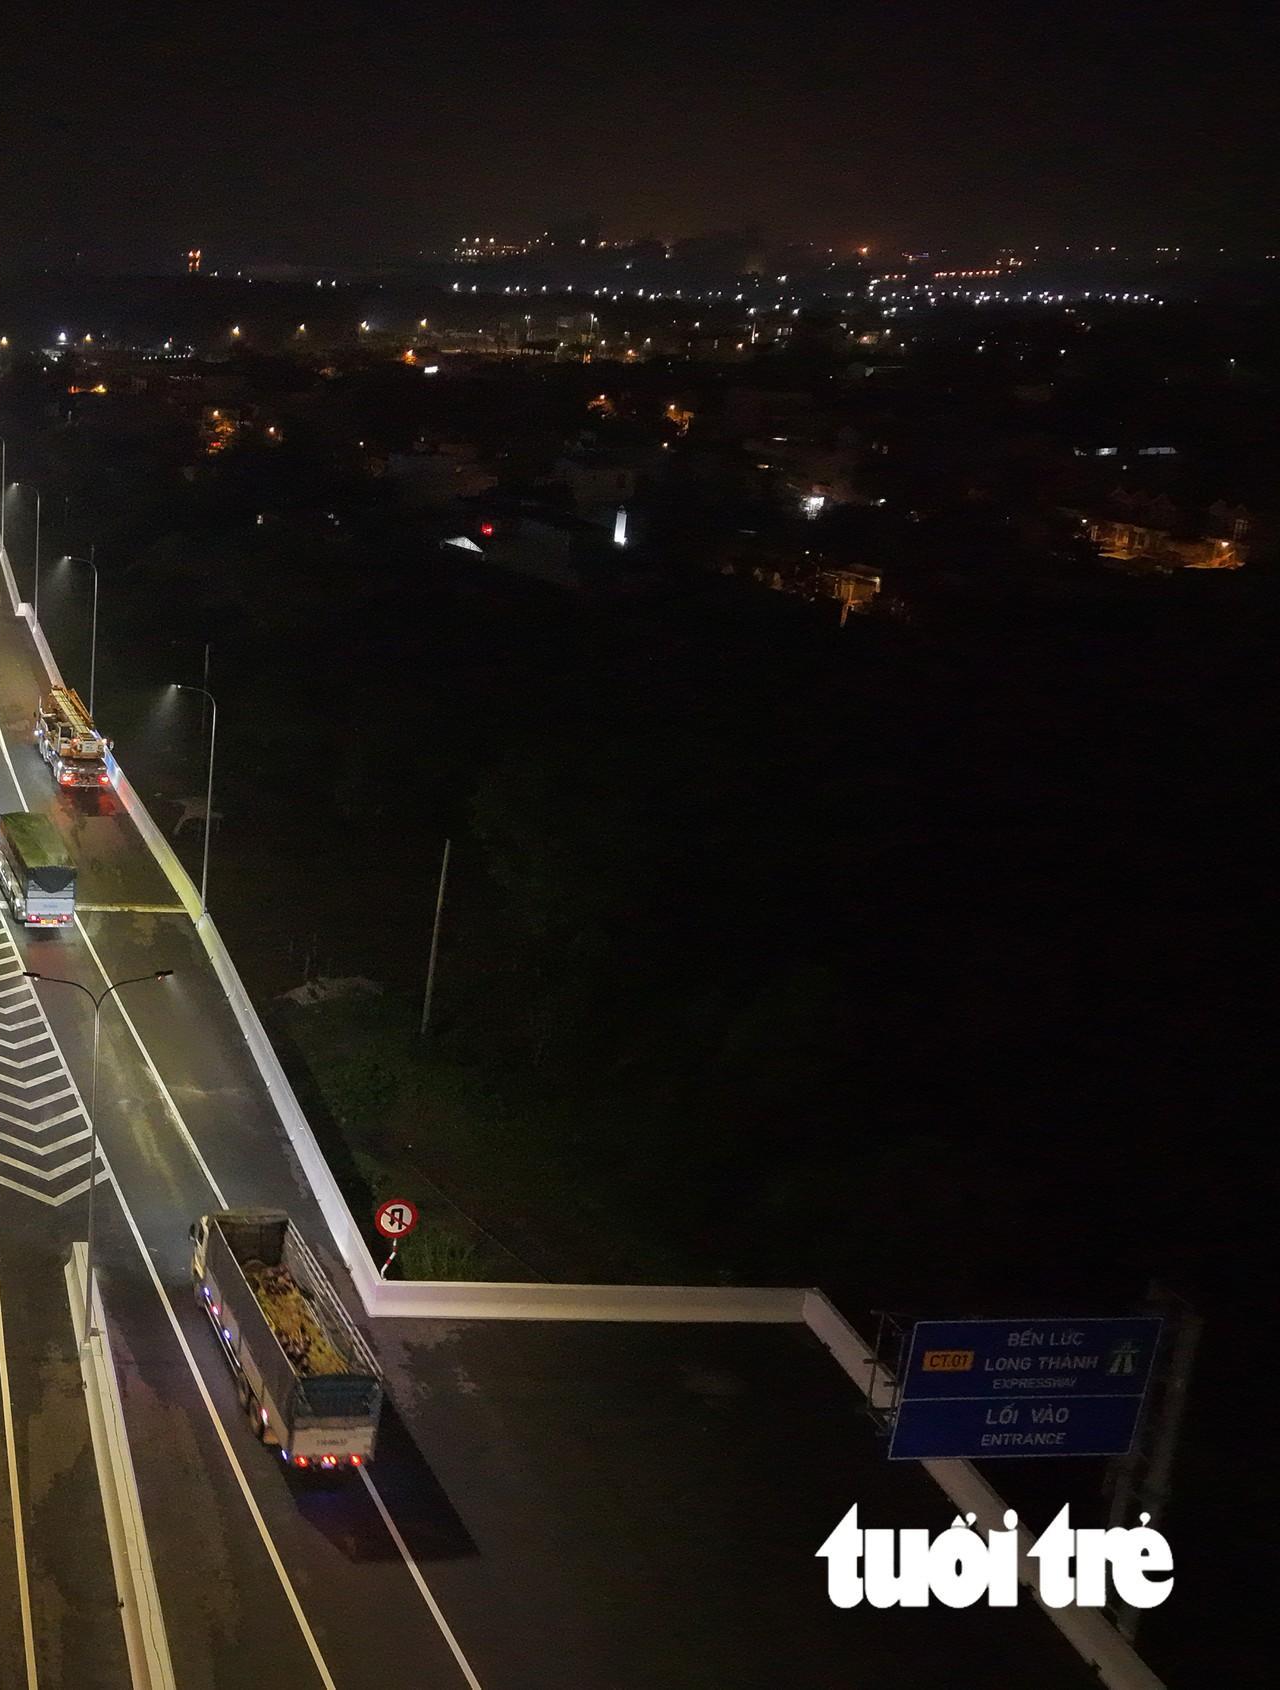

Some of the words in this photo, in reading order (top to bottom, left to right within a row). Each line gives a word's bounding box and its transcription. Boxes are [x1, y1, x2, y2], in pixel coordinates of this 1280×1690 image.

[1007, 1328, 1045, 1347] BẾN
[929, 1354, 970, 1369] CT.01
[984, 1357, 1032, 1372] LONG
[1038, 1352, 1099, 1370] THÀNH
[992, 1376, 1078, 1390] EXPRESSWAY
[985, 1402, 1020, 1425] LỐI
[1031, 1403, 1070, 1424] VÀO
[980, 1432, 1067, 1447] ENTRANCE
